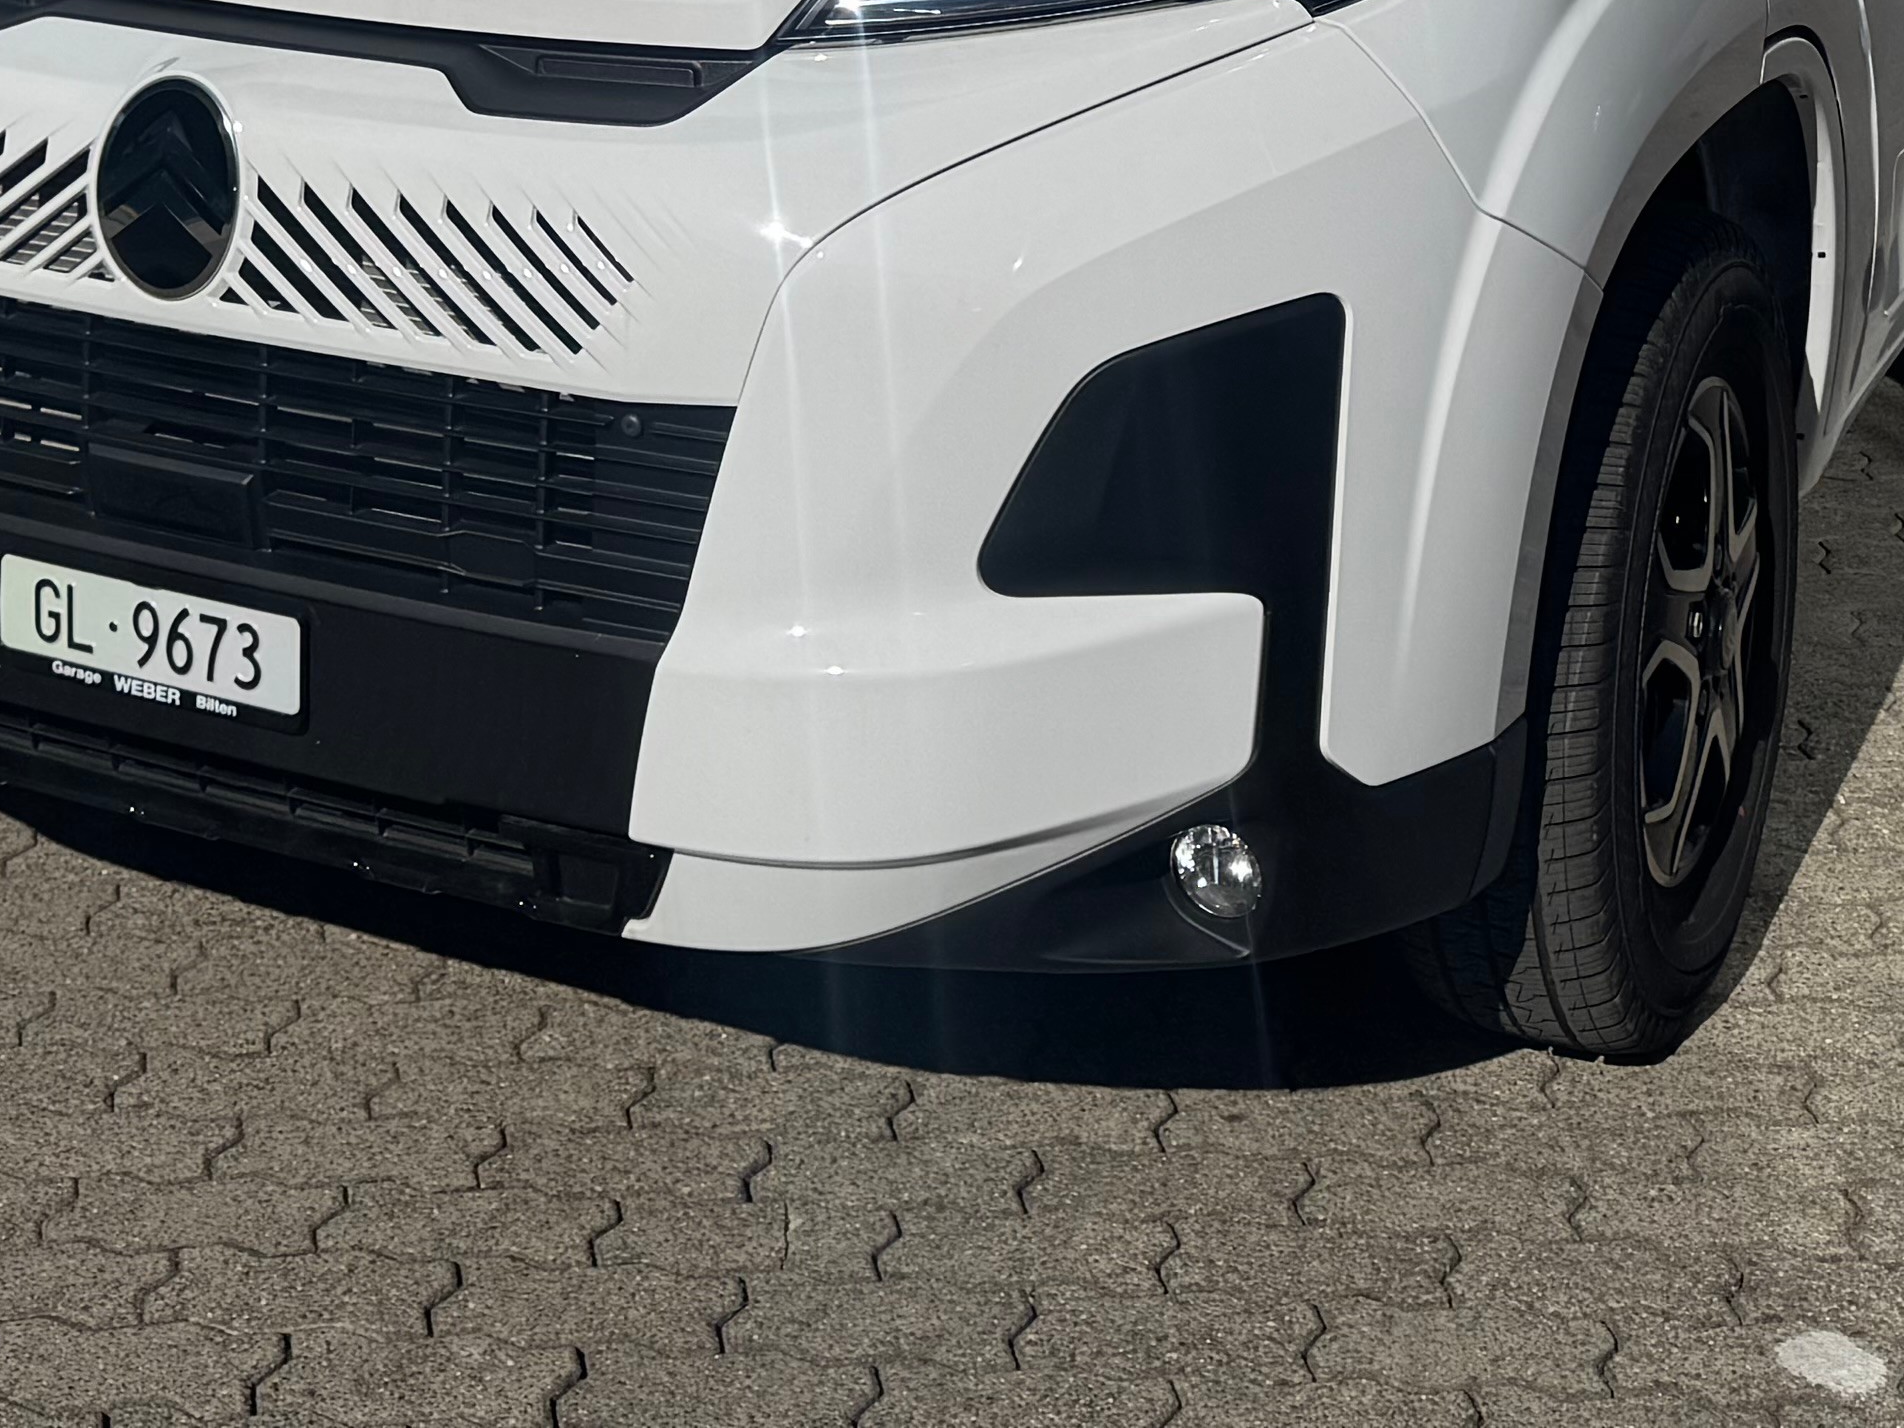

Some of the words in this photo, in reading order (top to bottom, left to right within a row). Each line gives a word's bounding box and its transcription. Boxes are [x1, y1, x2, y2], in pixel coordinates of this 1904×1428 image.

[33, 577, 95, 655] GL
[131, 599, 263, 692] 9673
[51, 658, 103, 685] Garage
[112, 672, 182, 707] WEBER
[194, 694, 238, 718] Bilten
